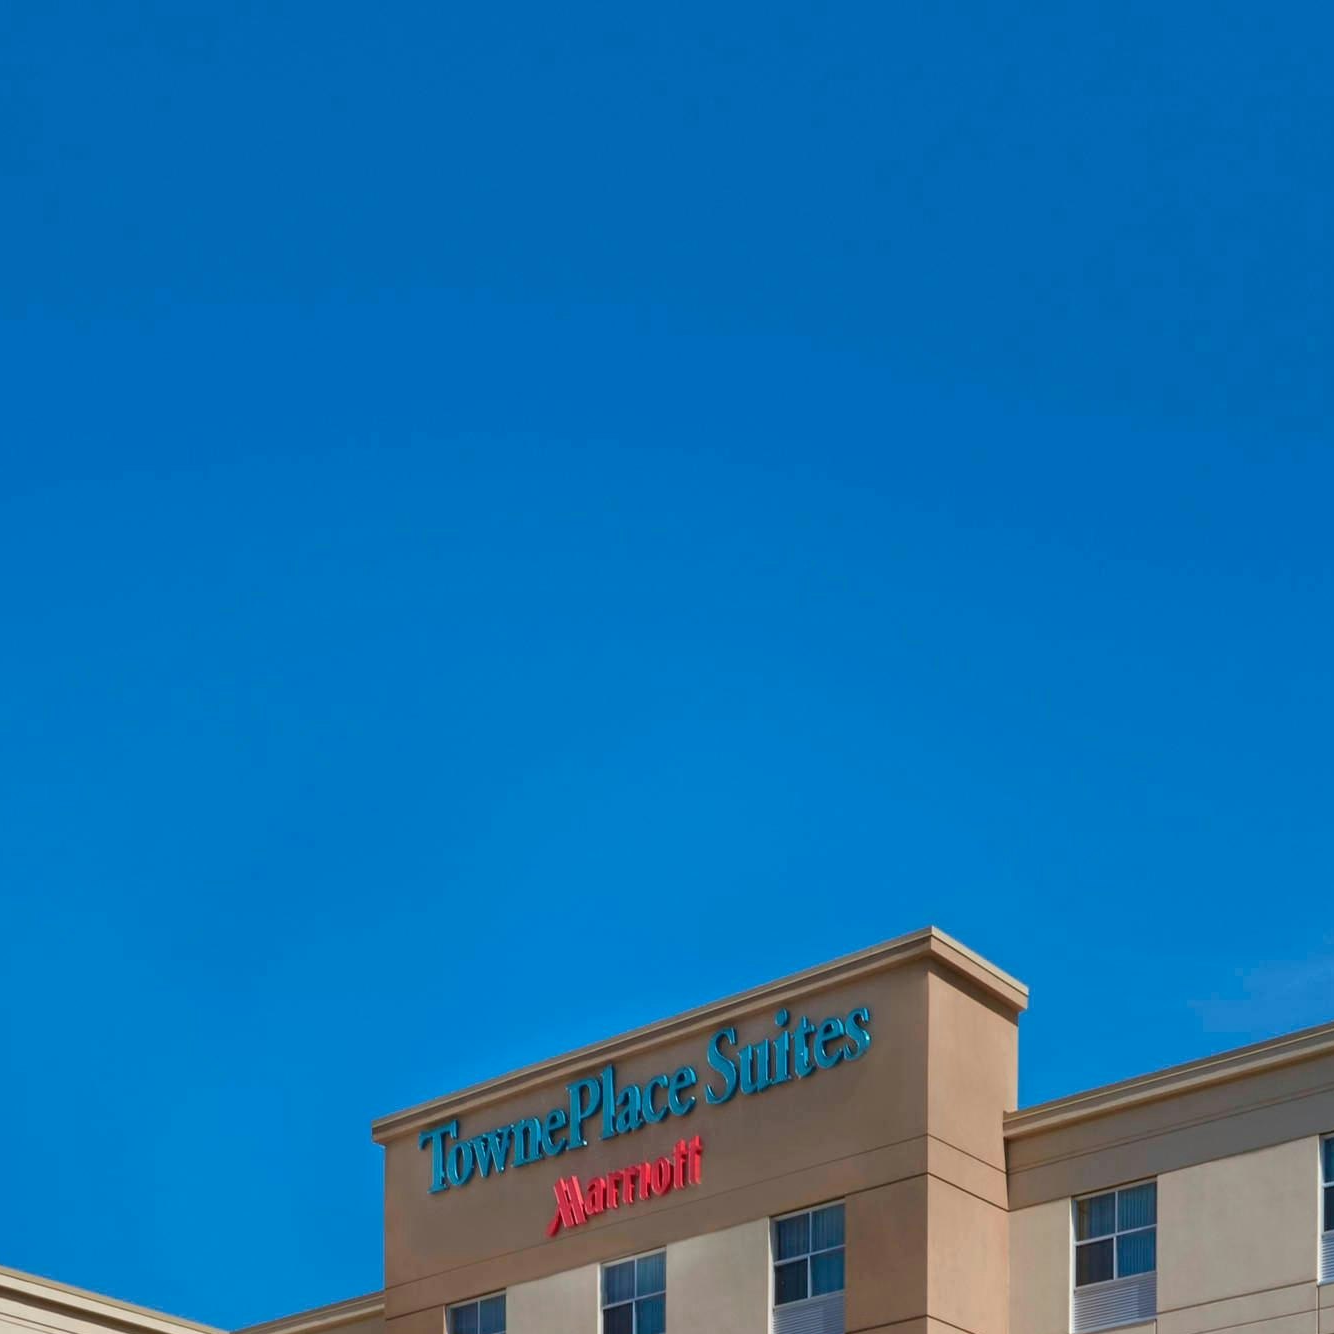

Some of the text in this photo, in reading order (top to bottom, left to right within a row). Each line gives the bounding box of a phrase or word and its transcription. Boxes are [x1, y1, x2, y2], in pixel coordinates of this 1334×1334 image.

[418, 1007, 872, 1195] TownePlace Suites
[546, 1135, 703, 1238] Marriott
